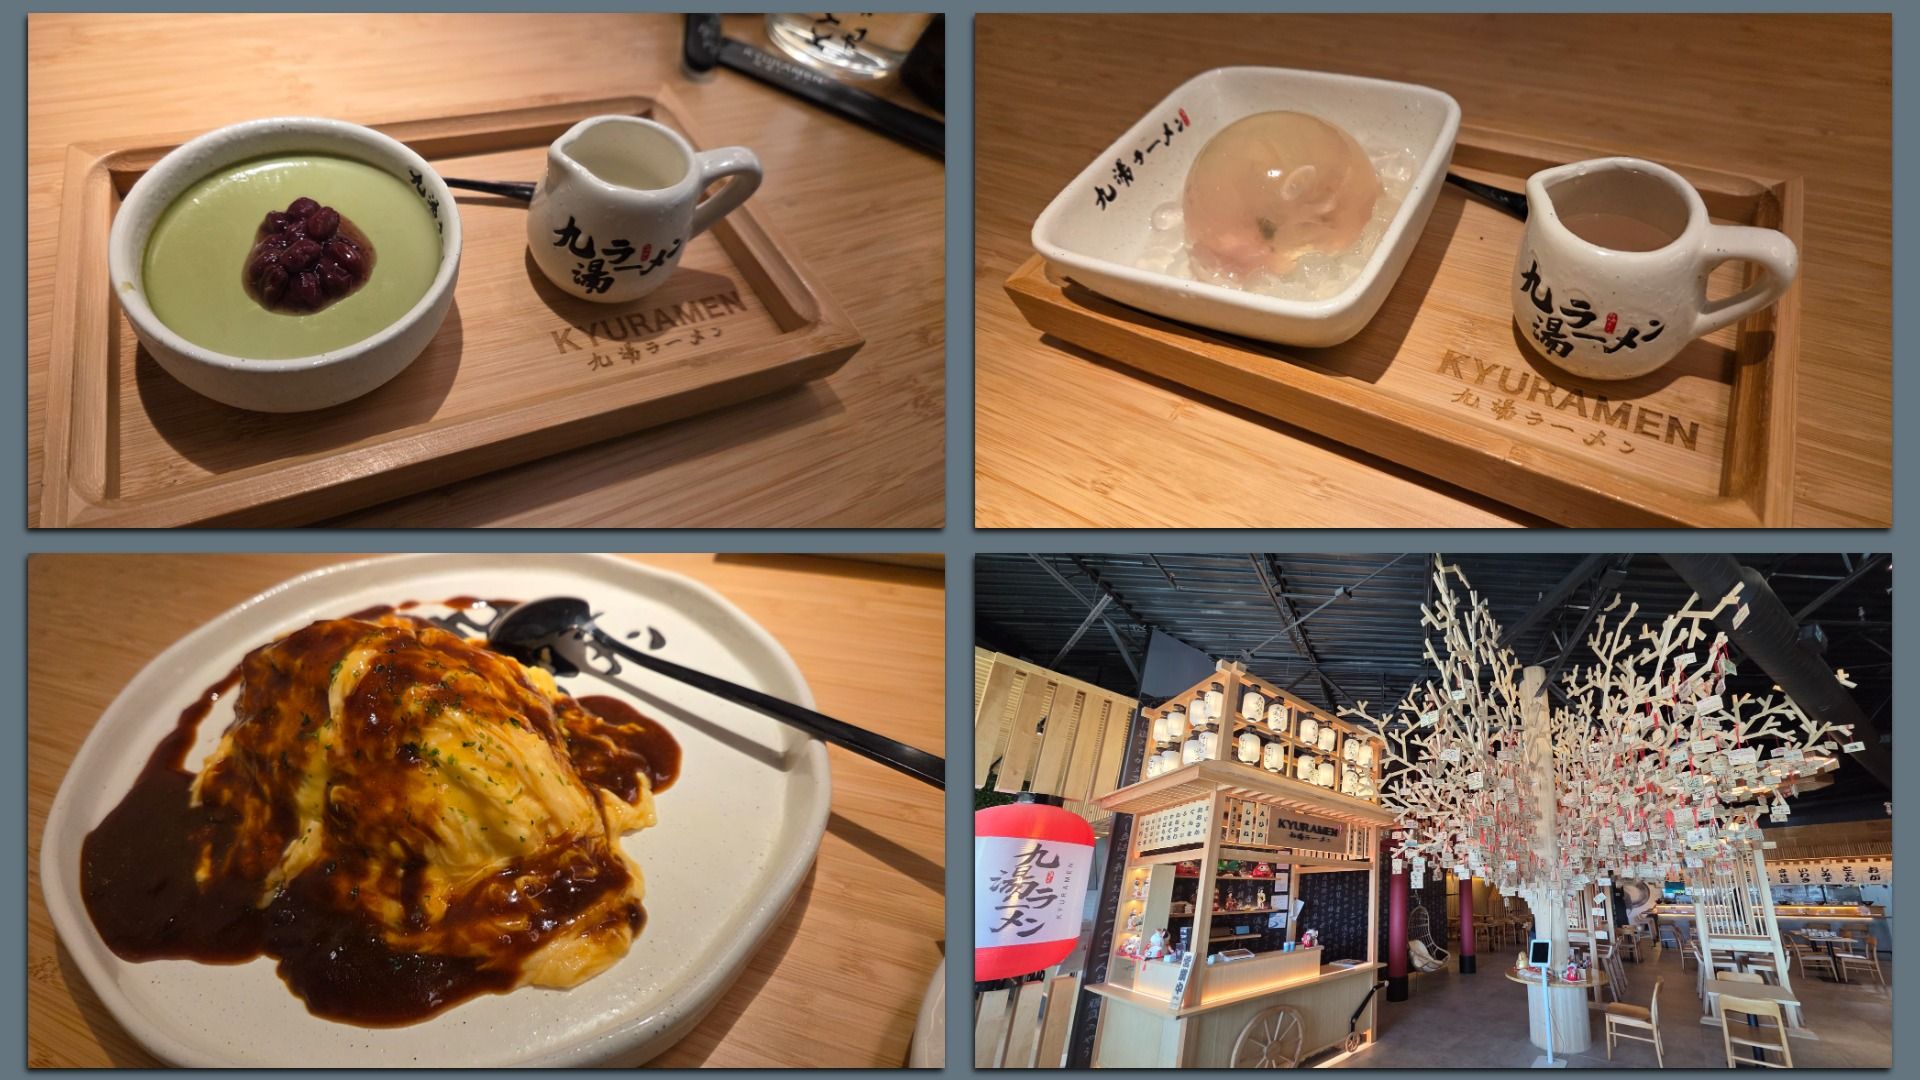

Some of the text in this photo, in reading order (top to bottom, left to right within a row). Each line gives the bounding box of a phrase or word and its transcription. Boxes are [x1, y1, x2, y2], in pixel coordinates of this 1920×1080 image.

[550, 290, 748, 354] KYURAMEN
[587, 327, 723, 372] 九湯ラーメン
[1437, 349, 1700, 451] KYURAMEN
[1451, 388, 1636, 454] 九湯ラーメン
[1278, 818, 1339, 838] KYURAMEN
